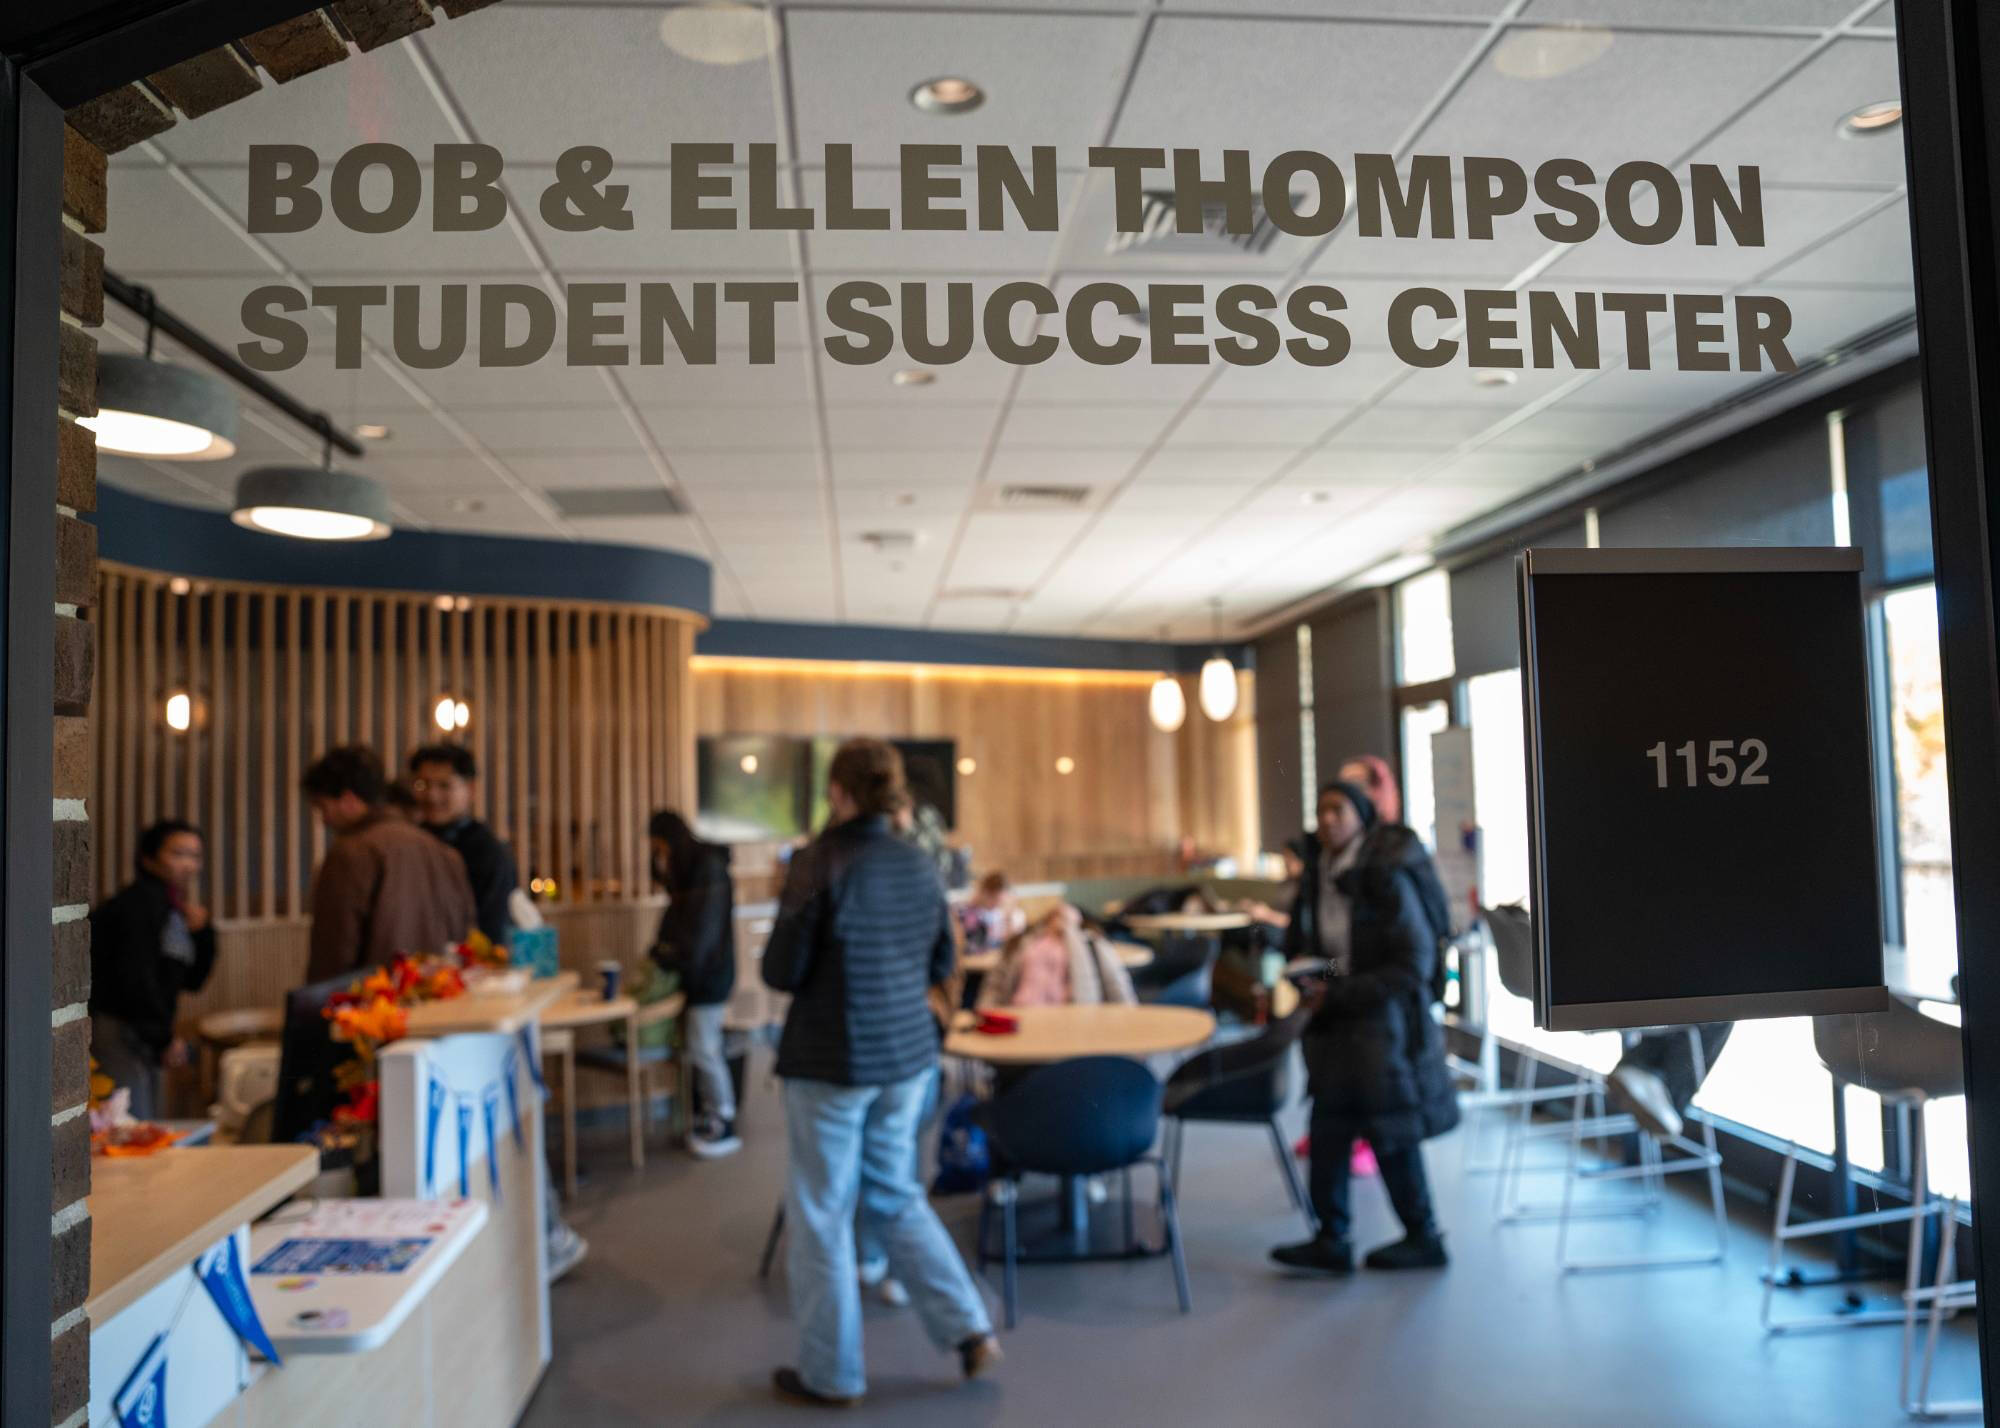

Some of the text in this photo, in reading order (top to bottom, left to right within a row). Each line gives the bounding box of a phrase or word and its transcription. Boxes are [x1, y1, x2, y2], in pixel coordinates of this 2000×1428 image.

[247, 143, 1766, 247] BOB & ELLEN THOMPSON
[237, 281, 1797, 372] STUDENT SUCCESS CENTER
[1646, 738, 1770, 788] 1152
